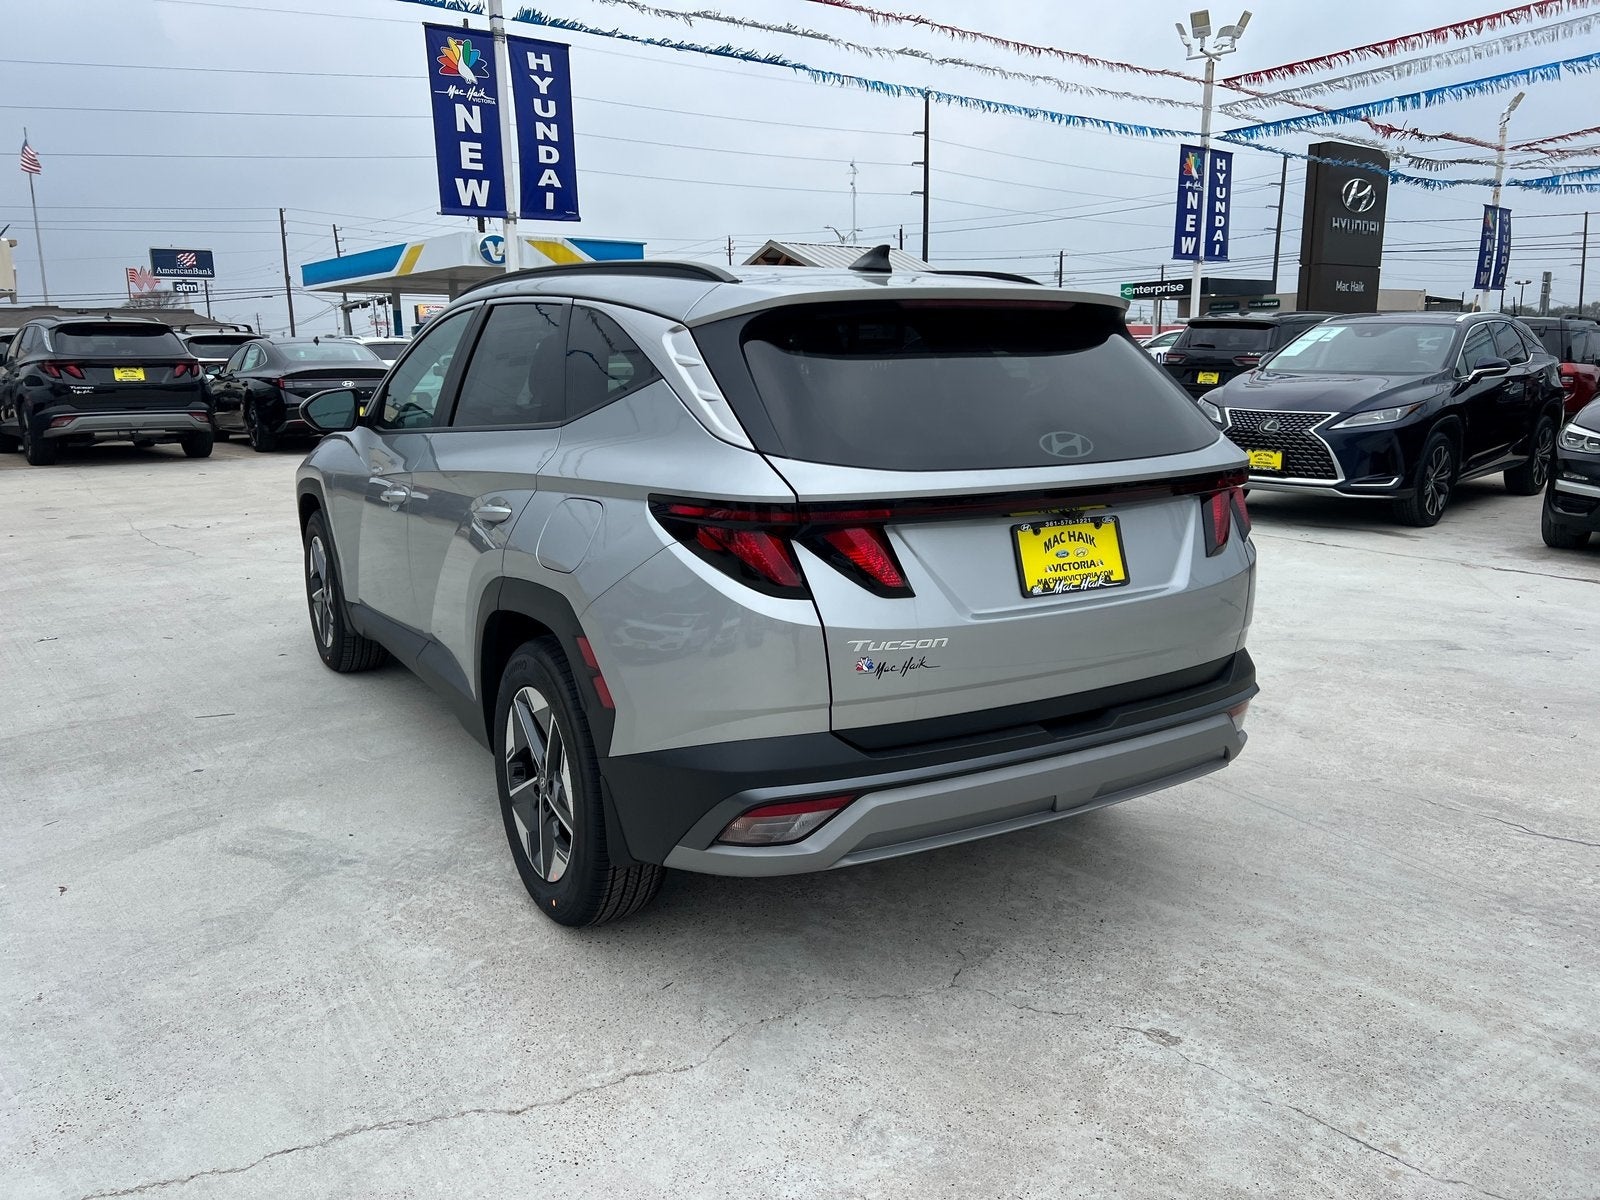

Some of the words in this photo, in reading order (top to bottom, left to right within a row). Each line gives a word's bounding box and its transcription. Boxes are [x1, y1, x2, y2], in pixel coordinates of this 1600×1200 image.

[441, 85, 466, 99] Mac
[467, 86, 492, 101] Haik
[527, 52, 562, 210] HYUNDAI
[455, 103, 490, 207] NEW
[1213, 158, 1226, 255] HYUNDAI
[1181, 191, 1198, 254] NEW
[1332, 216, 1380, 235] HYUNDAI
[1499, 213, 1509, 285] HYUNDAI
[156, 266, 213, 275] AmericanBank
[1480, 238, 1494, 285] NEW
[176, 283, 197, 291] atm
[1124, 283, 1184, 296] enterprise
[1335, 280, 1349, 291] Mac
[1350, 281, 1365, 292] Haik
[1043, 532, 1066, 553] MAC
[1067, 531, 1097, 548] HAIK
[1052, 560, 1096, 572] VICTORIA
[1050, 580, 1079, 593] Mac
[1081, 574, 1115, 590] Haik
[869, 661, 900, 680] Mac
[900, 656, 936, 677] Haik
